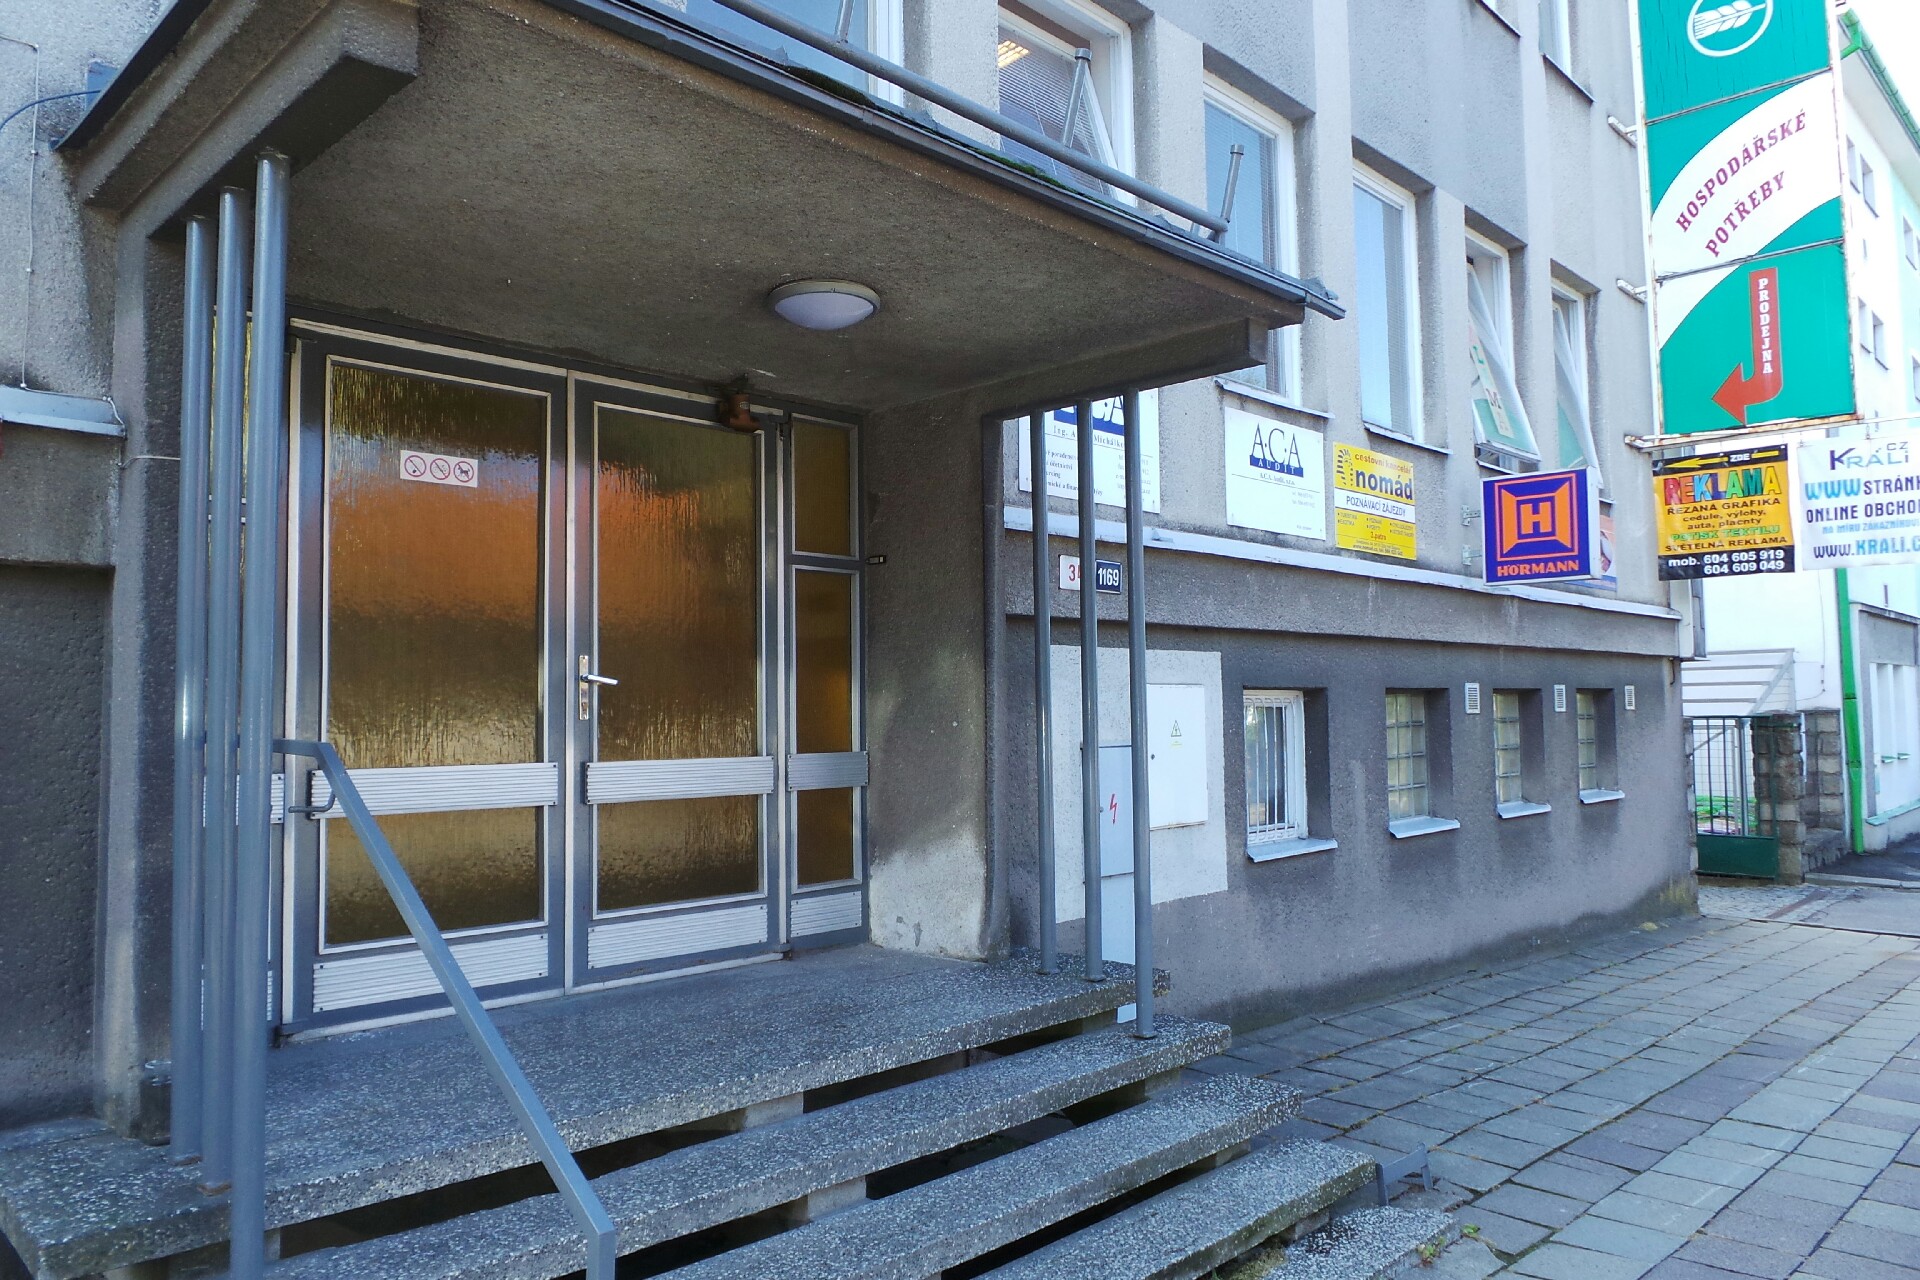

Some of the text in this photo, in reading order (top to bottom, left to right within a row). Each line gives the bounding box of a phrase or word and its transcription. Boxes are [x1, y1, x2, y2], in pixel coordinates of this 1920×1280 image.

[1675, 108, 1806, 233] HOSPODÁŘSKÉ
[1705, 171, 1785, 257] POTŘEBY
[1758, 277, 1773, 374] PRODEJNA
[1258, 458, 1296, 475] AUDIT
[1730, 453, 1750, 462] ZDE
[1355, 470, 1413, 500] nomád
[1663, 466, 1781, 506] REKLAMA
[1346, 495, 1406, 517] POZNÁVACÍ ZÁJEZDY
[1722, 497, 1781, 510] GRAFIKA
[1806, 498, 1920, 523] ONLINE OBCHO
[1520, 501, 1552, 534] H
[1671, 525, 1780, 541] POTISK TEXTILU
[1728, 536, 1787, 547] REKLAMA
[1668, 549, 1784, 567] mob. 604 605 919
[1704, 560, 1784, 574] 604 609 049
[1097, 567, 1119, 586] 1169
